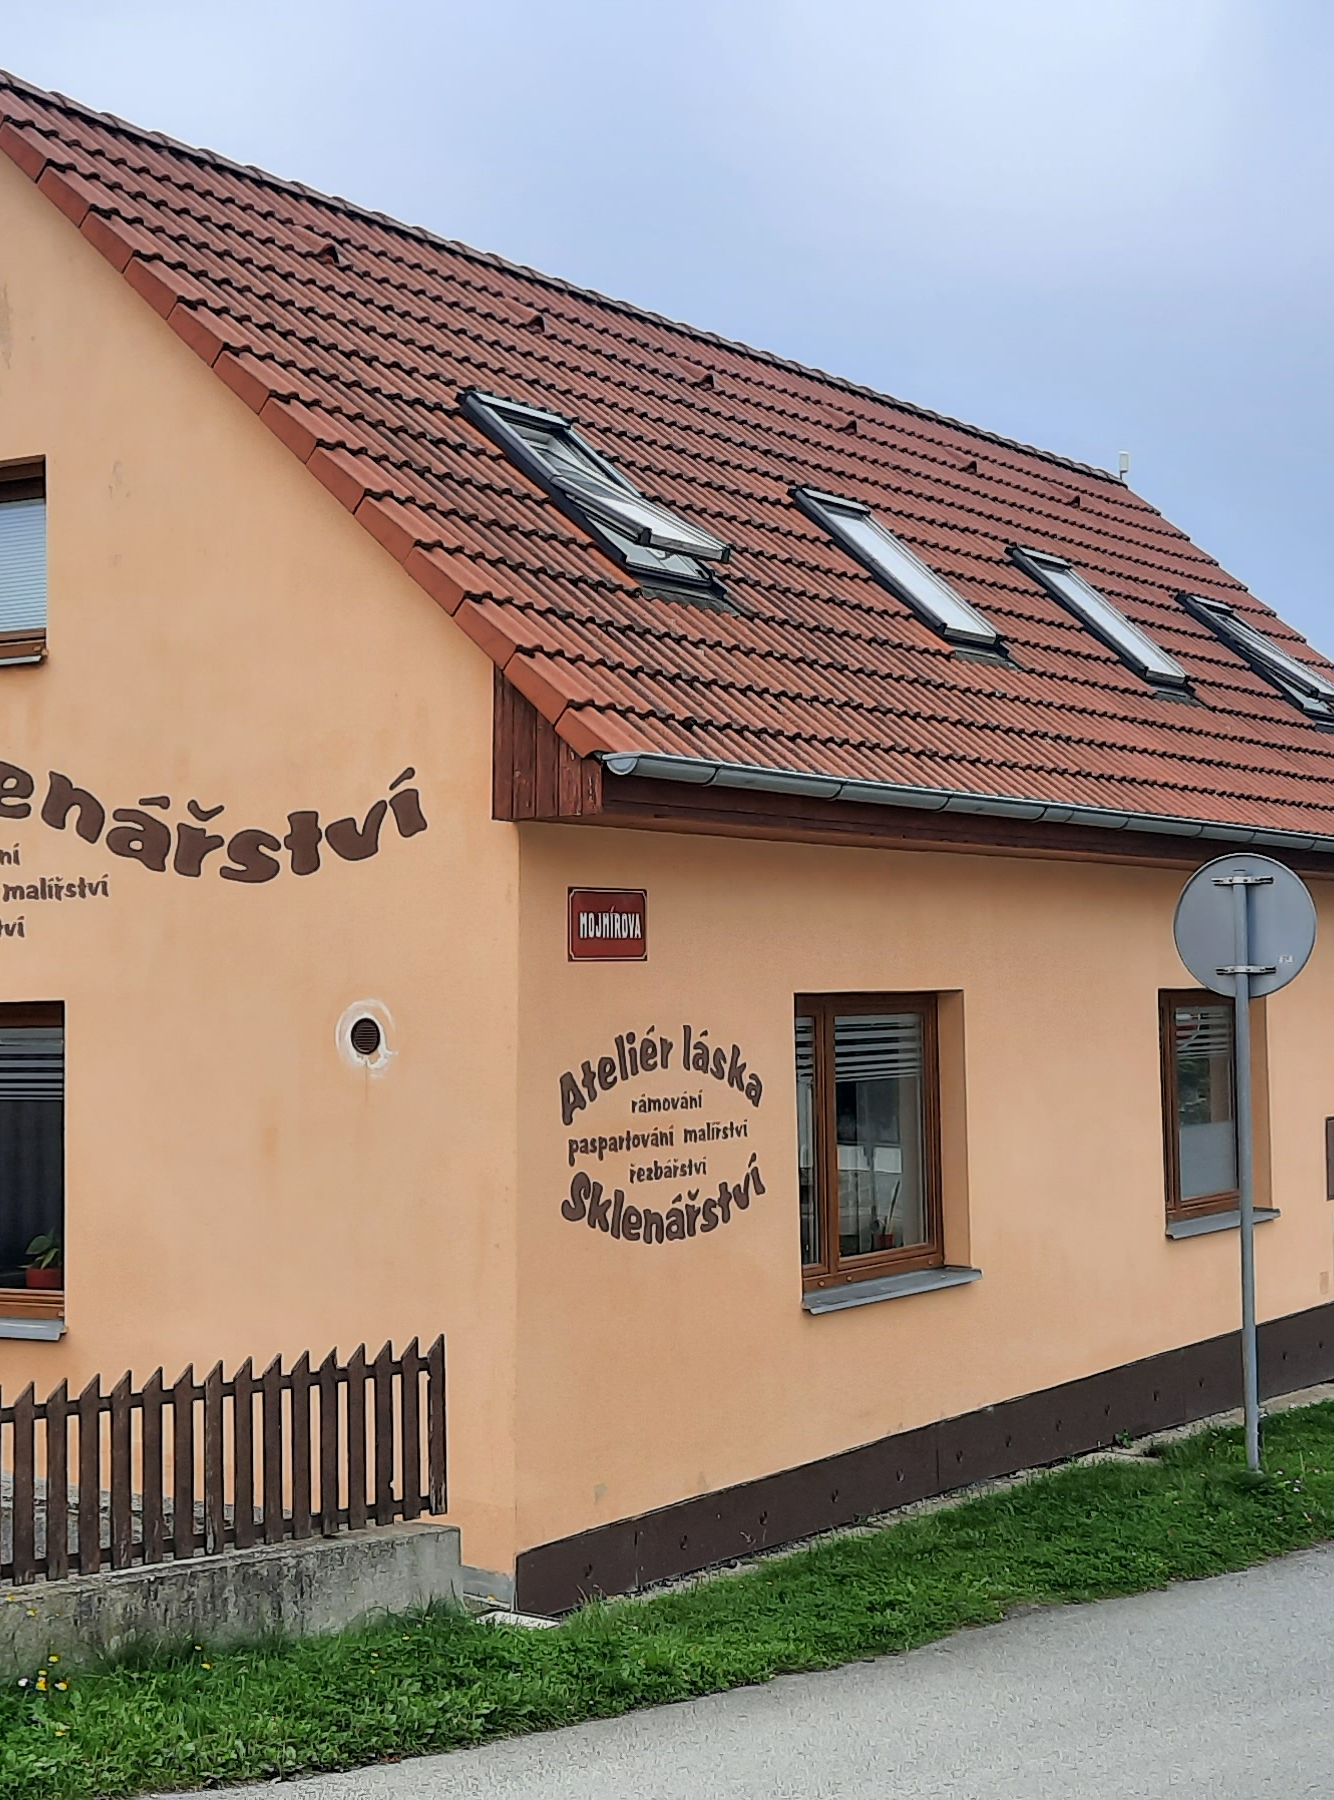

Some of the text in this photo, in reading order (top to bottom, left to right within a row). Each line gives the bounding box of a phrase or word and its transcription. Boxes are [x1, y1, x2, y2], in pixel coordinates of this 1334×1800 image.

[3, 874, 109, 903] malířství
[579, 905, 642, 939] MOJMÍROVA
[559, 1024, 763, 1126] Ateliér láska
[631, 1089, 703, 1114] rámování
[568, 1119, 748, 1167] paspartování malířství
[629, 1157, 707, 1184] řezbářství
[561, 1152, 765, 1245] Sklenářství
